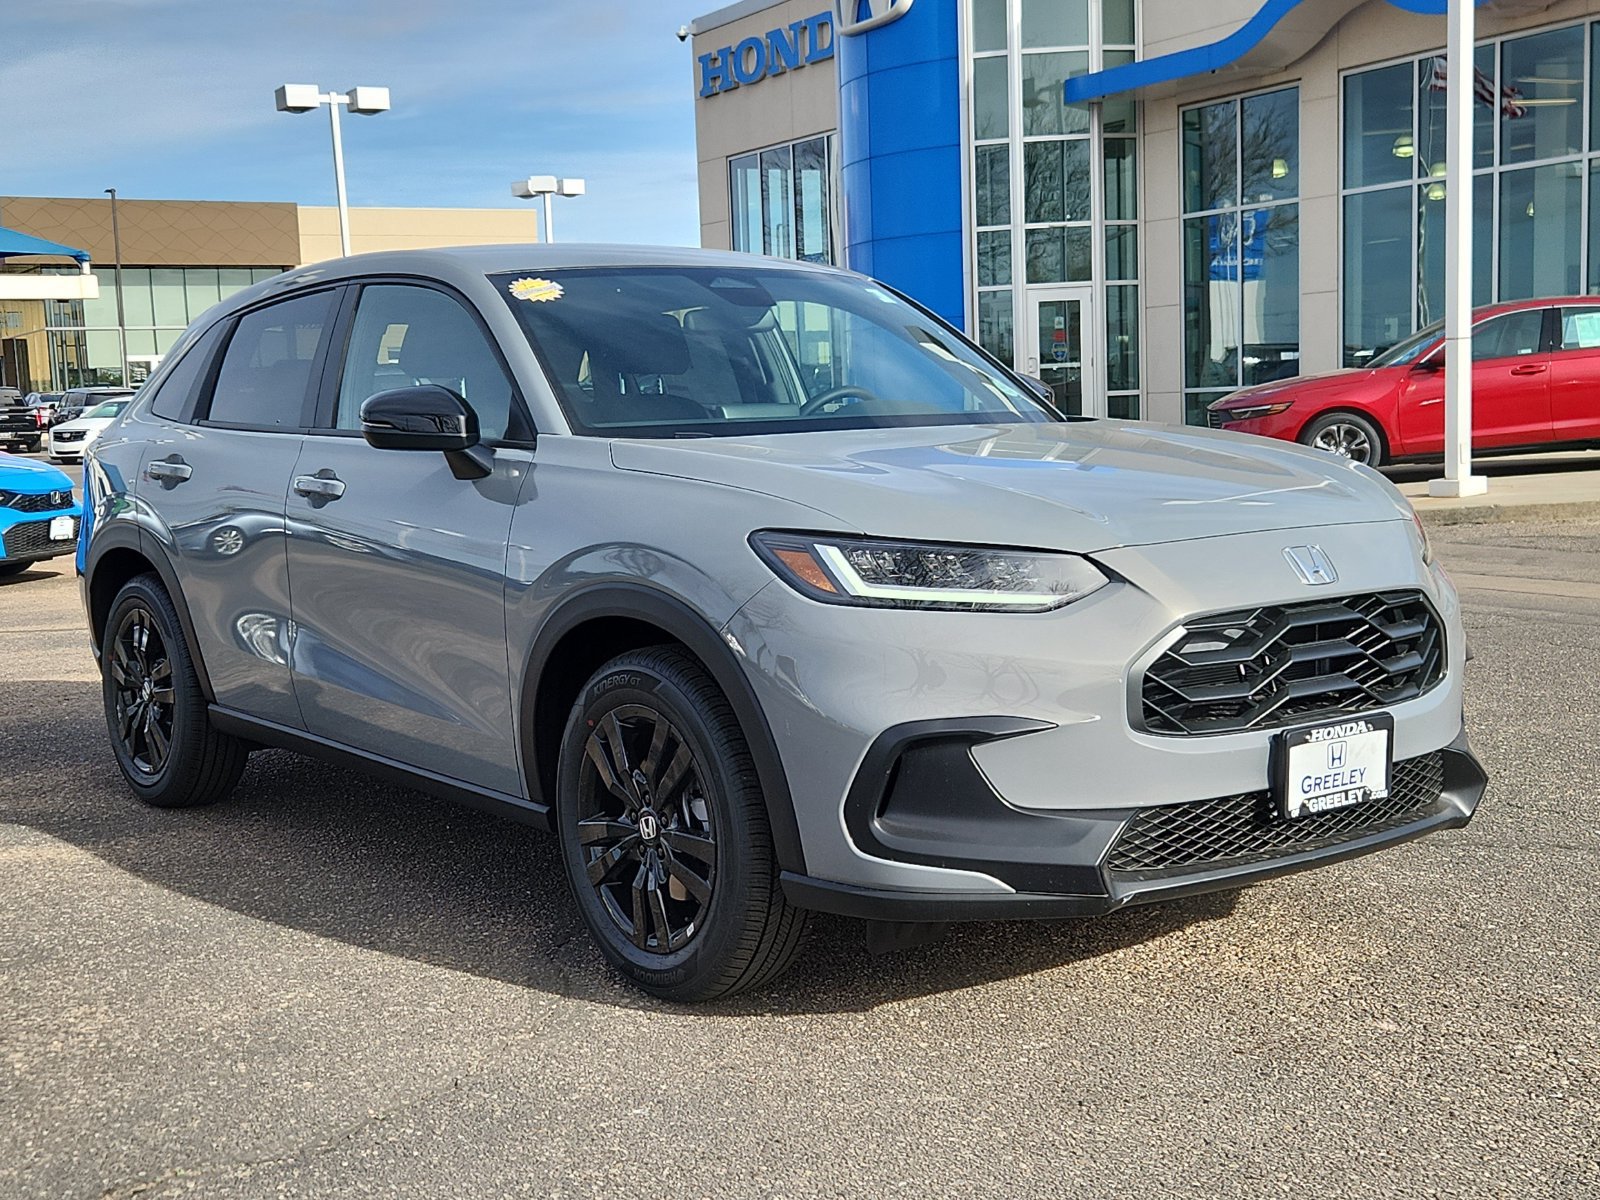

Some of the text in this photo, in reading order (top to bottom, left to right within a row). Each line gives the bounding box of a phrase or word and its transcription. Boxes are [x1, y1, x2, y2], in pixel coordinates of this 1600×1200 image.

[698, 10, 835, 98] HOND
[1308, 720, 1369, 743] HONDA
[1301, 767, 1367, 794] GREELEY
[1308, 788, 1365, 813] GREELEY
